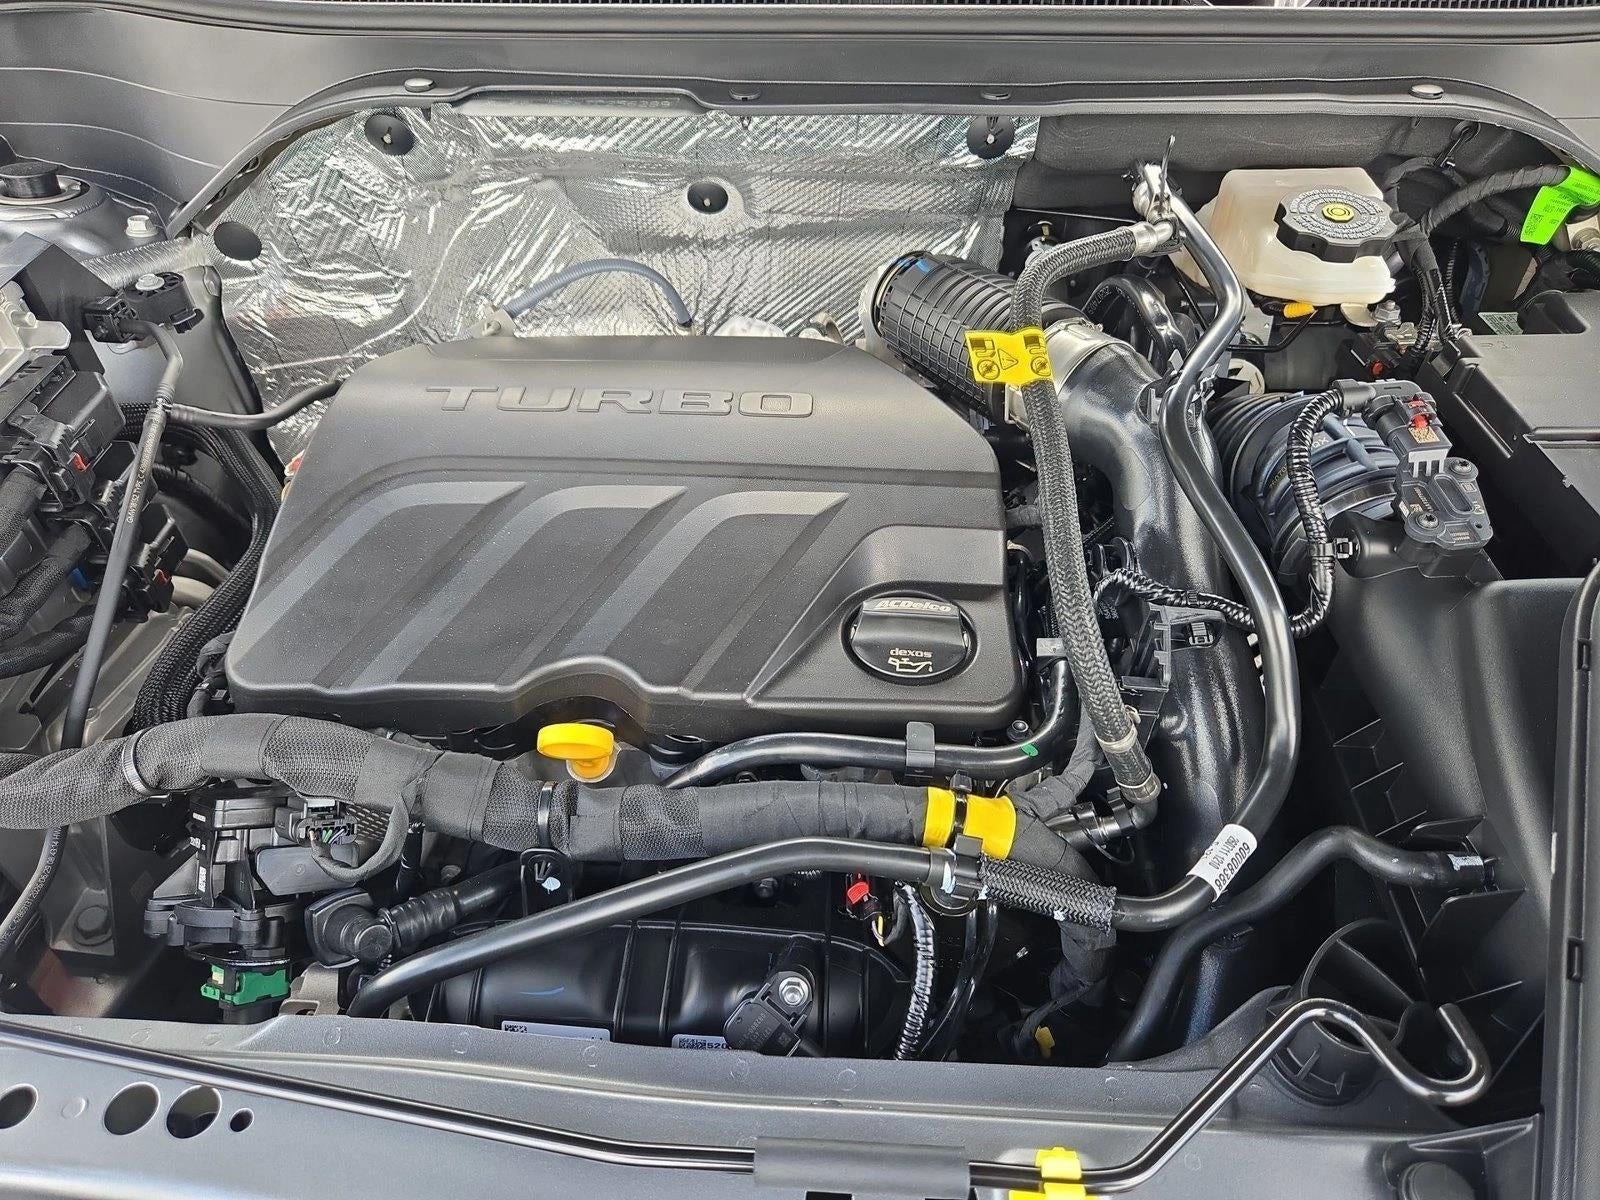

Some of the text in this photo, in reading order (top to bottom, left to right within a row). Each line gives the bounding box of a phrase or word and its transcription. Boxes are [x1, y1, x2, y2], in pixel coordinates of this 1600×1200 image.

[426, 385, 814, 419] TURBO
[875, 600, 952, 613] ACDelco
[889, 647, 933, 658] dexos
[1215, 842, 1251, 891] 60008388
